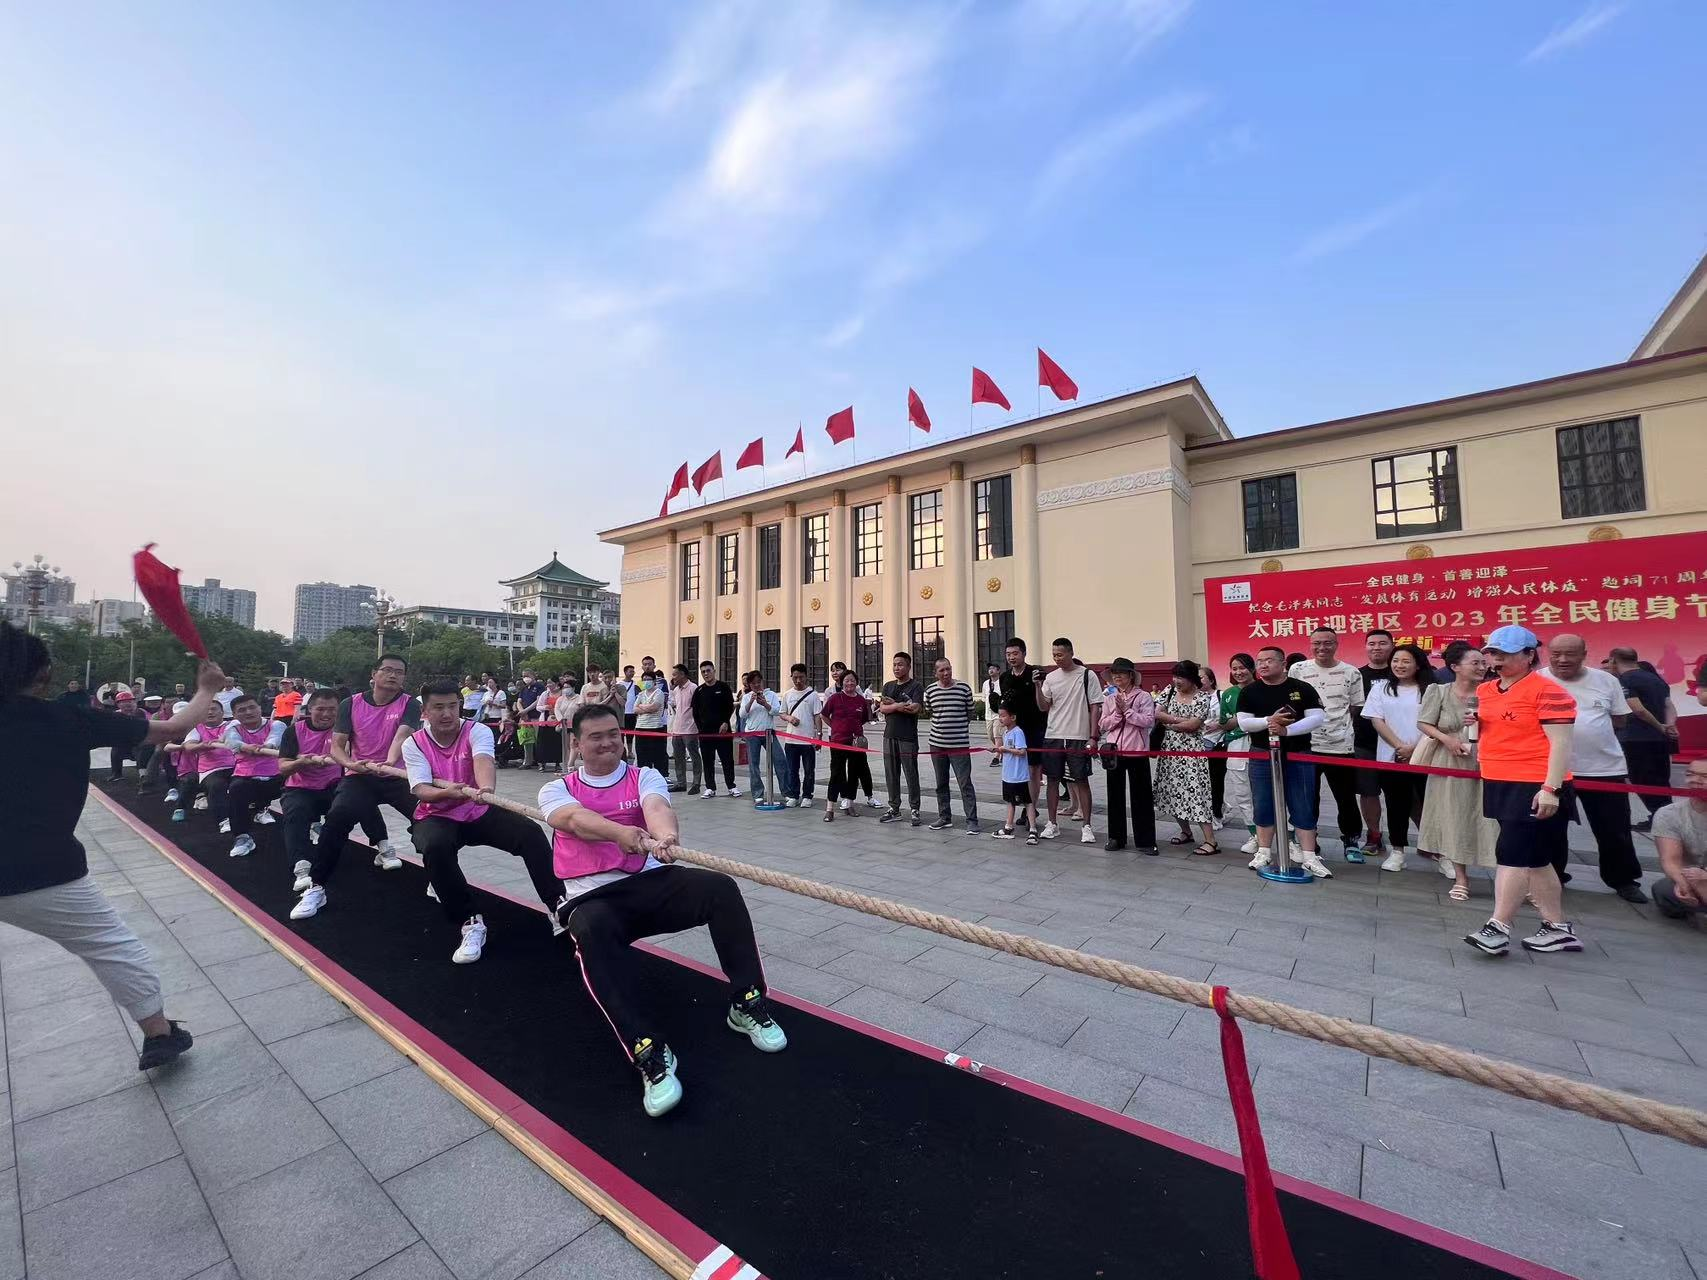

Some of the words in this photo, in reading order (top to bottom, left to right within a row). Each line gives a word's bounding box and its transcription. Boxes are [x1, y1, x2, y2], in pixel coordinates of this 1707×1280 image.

[1248, 611, 1403, 639] 太原市迎泽区
[1414, 610, 1485, 629] 2023
[1497, 593, 1707, 626] 年全民健身节
